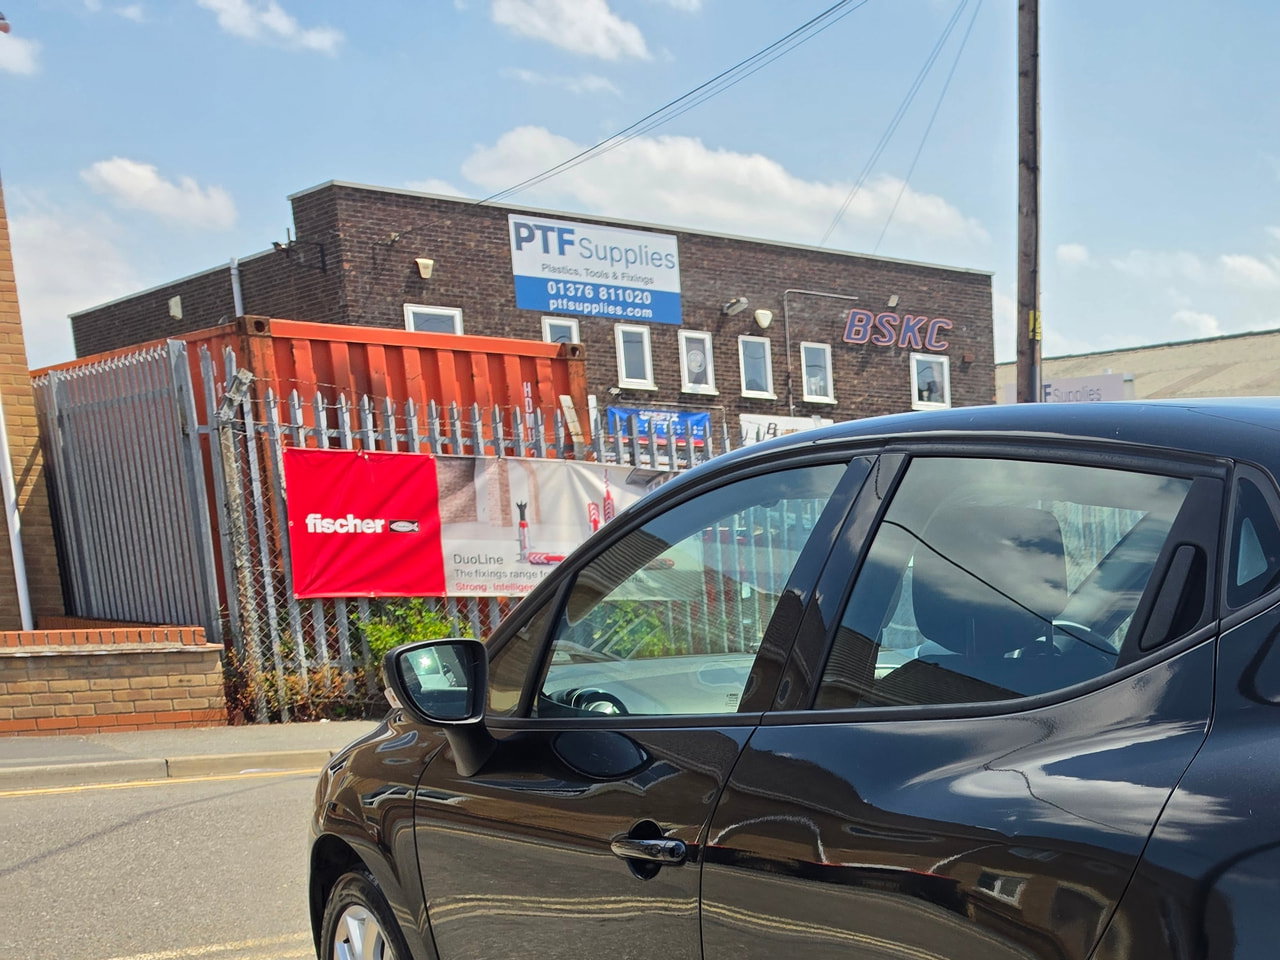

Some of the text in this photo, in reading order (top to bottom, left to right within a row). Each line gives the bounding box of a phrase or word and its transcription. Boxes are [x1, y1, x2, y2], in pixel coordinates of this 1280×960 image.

[513, 221, 676, 270] PTF Supplies
[541, 263, 654, 286] Plastics, Tools & Fixings
[547, 281, 652, 305] 01376 811020
[549, 298, 653, 318] ptfsupplies.com
[842, 308, 953, 351] BSKC
[305, 513, 385, 534] fischer
[453, 554, 504, 565] DuoLine
[454, 569, 473, 578] The
[475, 569, 508, 579] fixings
[510, 571, 539, 580] range
[455, 582, 488, 592] Strong
